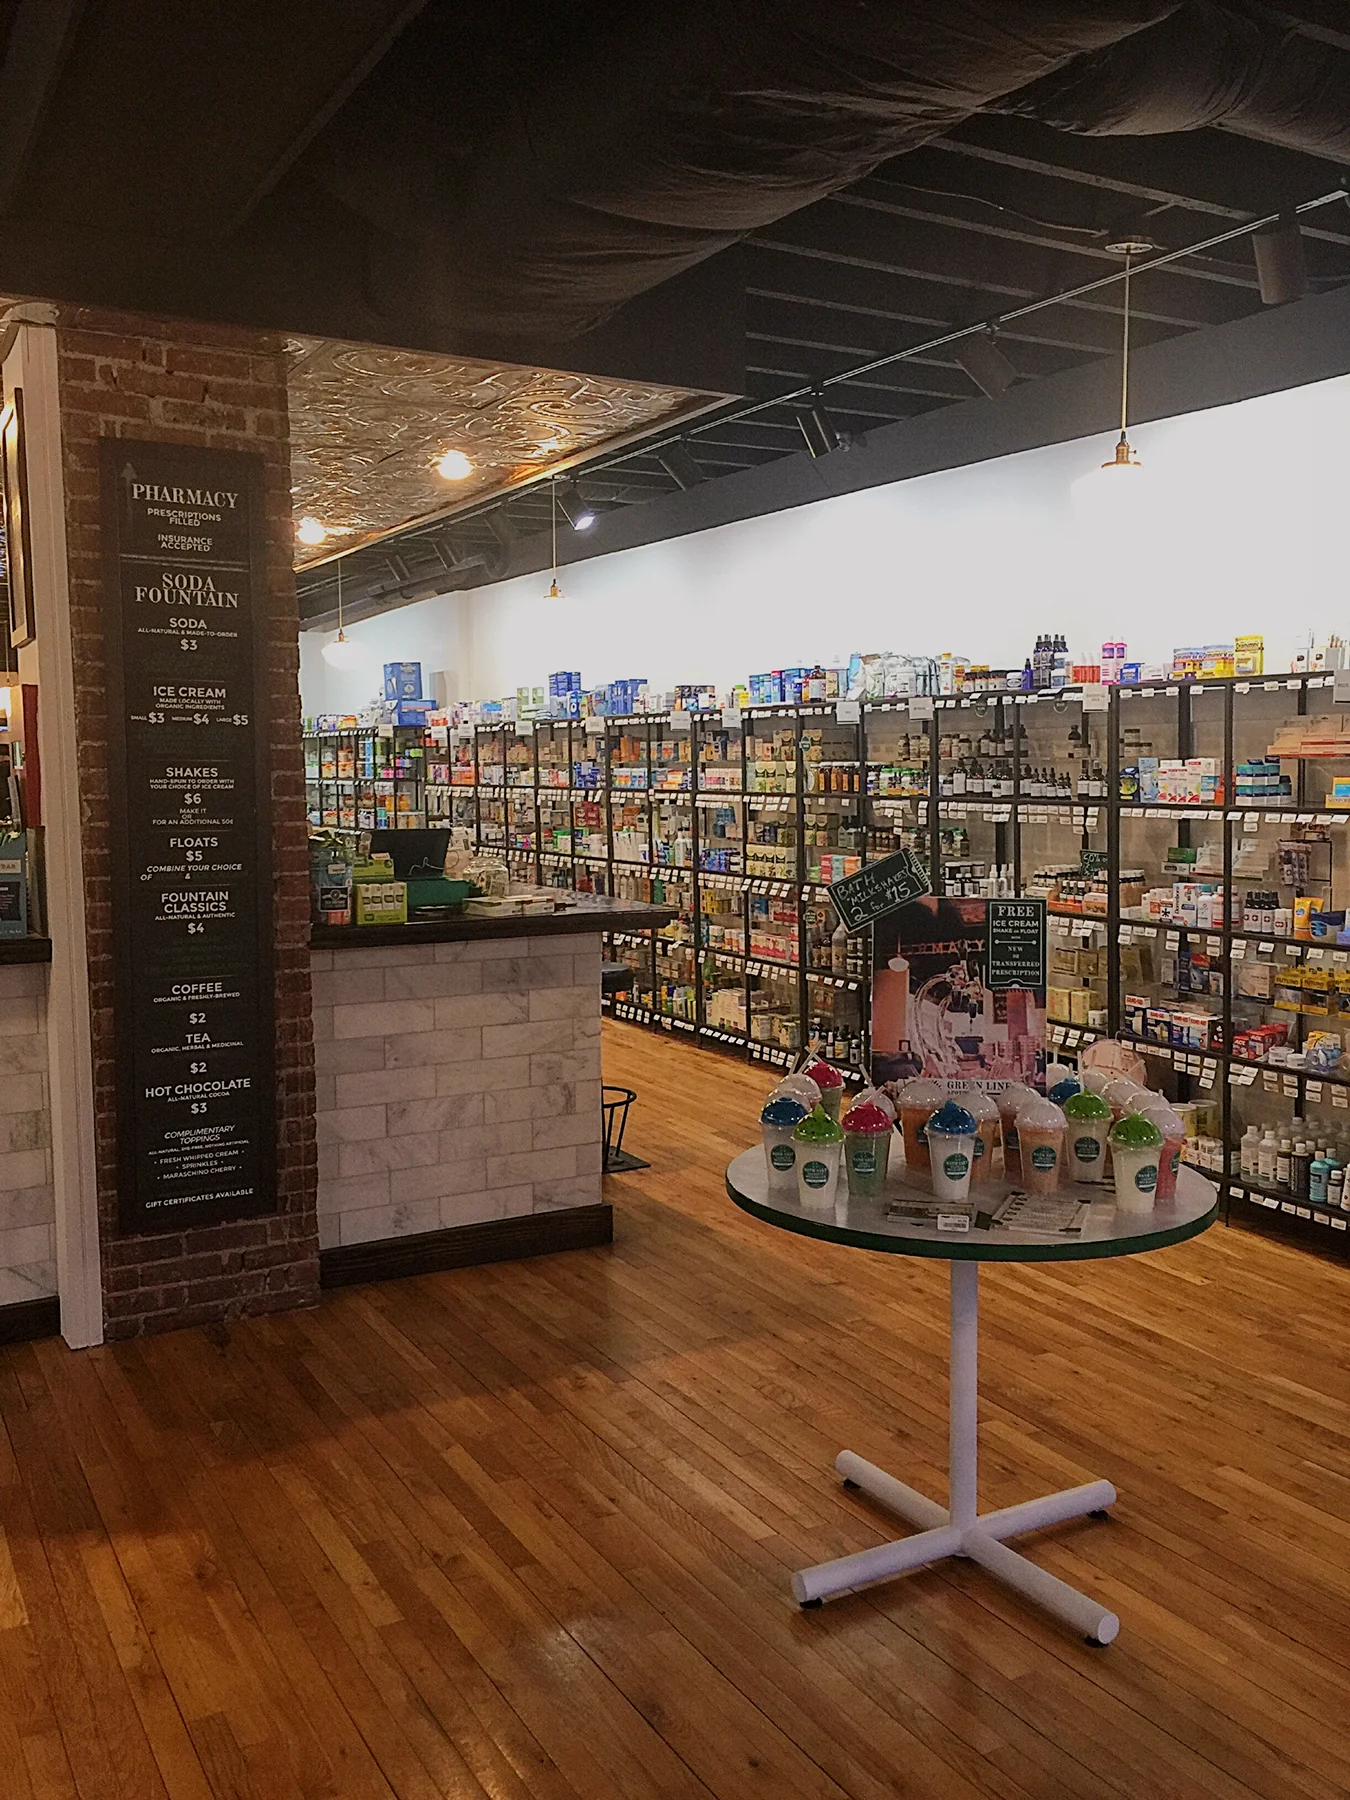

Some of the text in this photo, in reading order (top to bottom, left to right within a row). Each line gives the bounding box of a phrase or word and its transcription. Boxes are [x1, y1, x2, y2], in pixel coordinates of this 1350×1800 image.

[132, 483, 238, 508] PHARMACY
[147, 508, 221, 521] PRESCRIPTIONS
[169, 518, 200, 526] FILLED
[158, 534, 213, 546] INSURANCE
[160, 541, 210, 552] ACCEPTED
[162, 573, 216, 591] SODA
[135, 586, 239, 608] FOUNTAIN
[169, 618, 207, 629] SODA
[137, 627, 180, 635] ALL-NATURAL
[186, 630, 238, 638] MADE-TO-ORDER
[180, 638, 198, 651] $3
[153, 686, 226, 698] ICE CREAM
[148, 711, 165, 724] $3
[193, 713, 210, 725] $4
[232, 714, 249, 726] $5
[165, 767, 218, 778] SHAKES
[184, 792, 202, 805] $6
[169, 837, 219, 848] FLOATS
[185, 850, 203, 862] $5
[146, 865, 185, 873] COMBINE
[211, 863, 242, 871] CHOICE
[837, 872, 876, 900] BATH
[161, 891, 229, 902] FOUNTAIN
[163, 902, 227, 913] CLASSICS
[850, 906, 868, 922] 2
[869, 901, 885, 912] for
[997, 905, 1035, 917] FREE
[187, 922, 205, 935] $4
[1008, 920, 1039, 928] CREAM
[991, 960, 1040, 968] TRANSFERRED
[171, 982, 222, 995] COFFEE
[188, 992, 240, 1000] FRESHLY-BREWED
[189, 1013, 207, 1025] $2
[185, 1033, 211, 1043] TEA
[190, 1062, 207, 1074] $2
[145, 1078, 251, 1098] HOT CHOCOLATE
[947, 1081, 983, 1090] GREN
[167, 1094, 207, 1102] ALL-NATURAL
[190, 1102, 208, 1114] $3
[164, 1125, 235, 1139] COMPLIMENTARY
[180, 1134, 220, 1145] TOPPINGS
[159, 1149, 239, 1164] FRESH WHIPPED CREAM
[181, 1160, 218, 1170] SPRINKLES
[162, 1165, 236, 1180] MARASCHINO CHERRY
[145, 1188, 254, 1209] GIFT CERTIFICATES AVAILABLE
